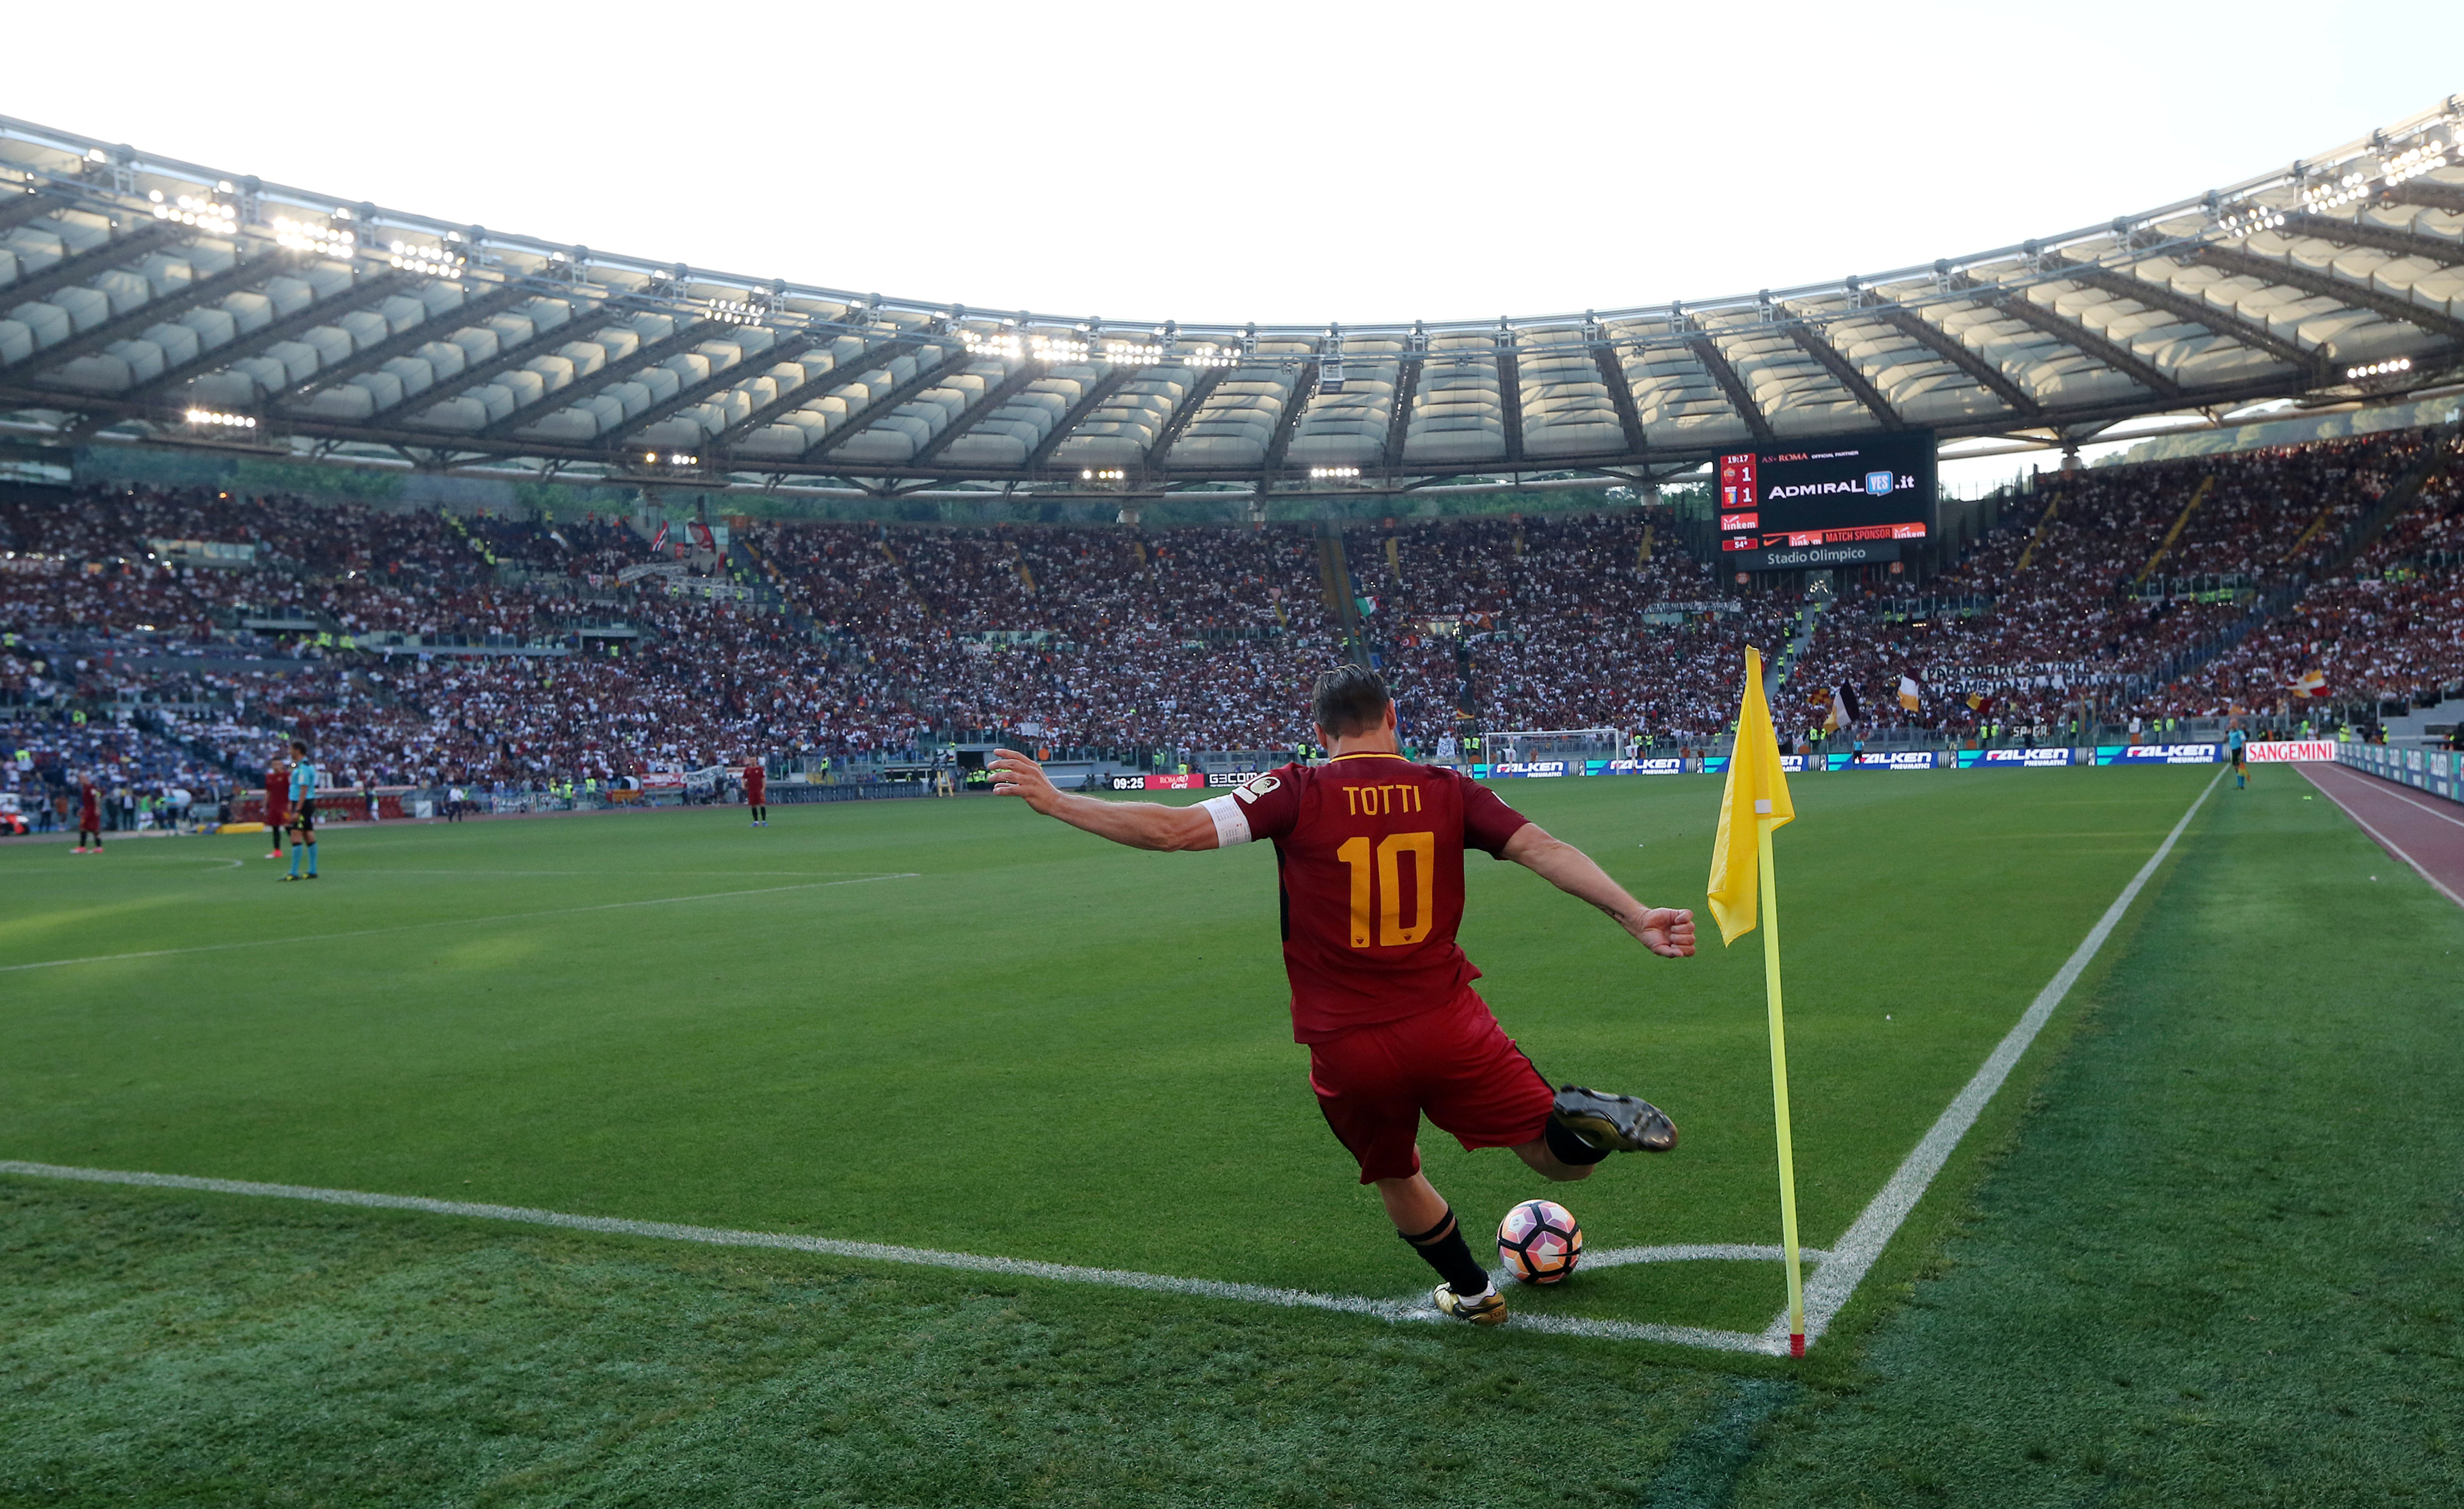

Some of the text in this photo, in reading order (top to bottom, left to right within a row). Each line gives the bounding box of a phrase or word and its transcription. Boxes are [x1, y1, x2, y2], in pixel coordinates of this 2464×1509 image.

[1727, 454, 1749, 464] 19:17
[1779, 453, 1808, 462] ROMA
[1742, 467, 1752, 482] 1
[1743, 487, 1752, 503] 1
[1768, 479, 1865, 499] ADMIRAL
[1723, 516, 1756, 530] linkem
[1825, 528, 1892, 543] MATCH SPONSOR
[1893, 527, 1926, 539] linkem
[1767, 547, 1866, 564] Stadio Olimpico
[1986, 748, 2069, 761] FALKEN
[2126, 744, 2215, 758] FALKEN
[2249, 743, 2332, 761] SANGEMINI
[1496, 762, 1564, 773] FALKEN
[1610, 759, 1680, 770] FALKEN
[1113, 777, 1144, 790] 09:25
[1342, 785, 1422, 816] TOTTI
[1337, 831, 1435, 947] 10
